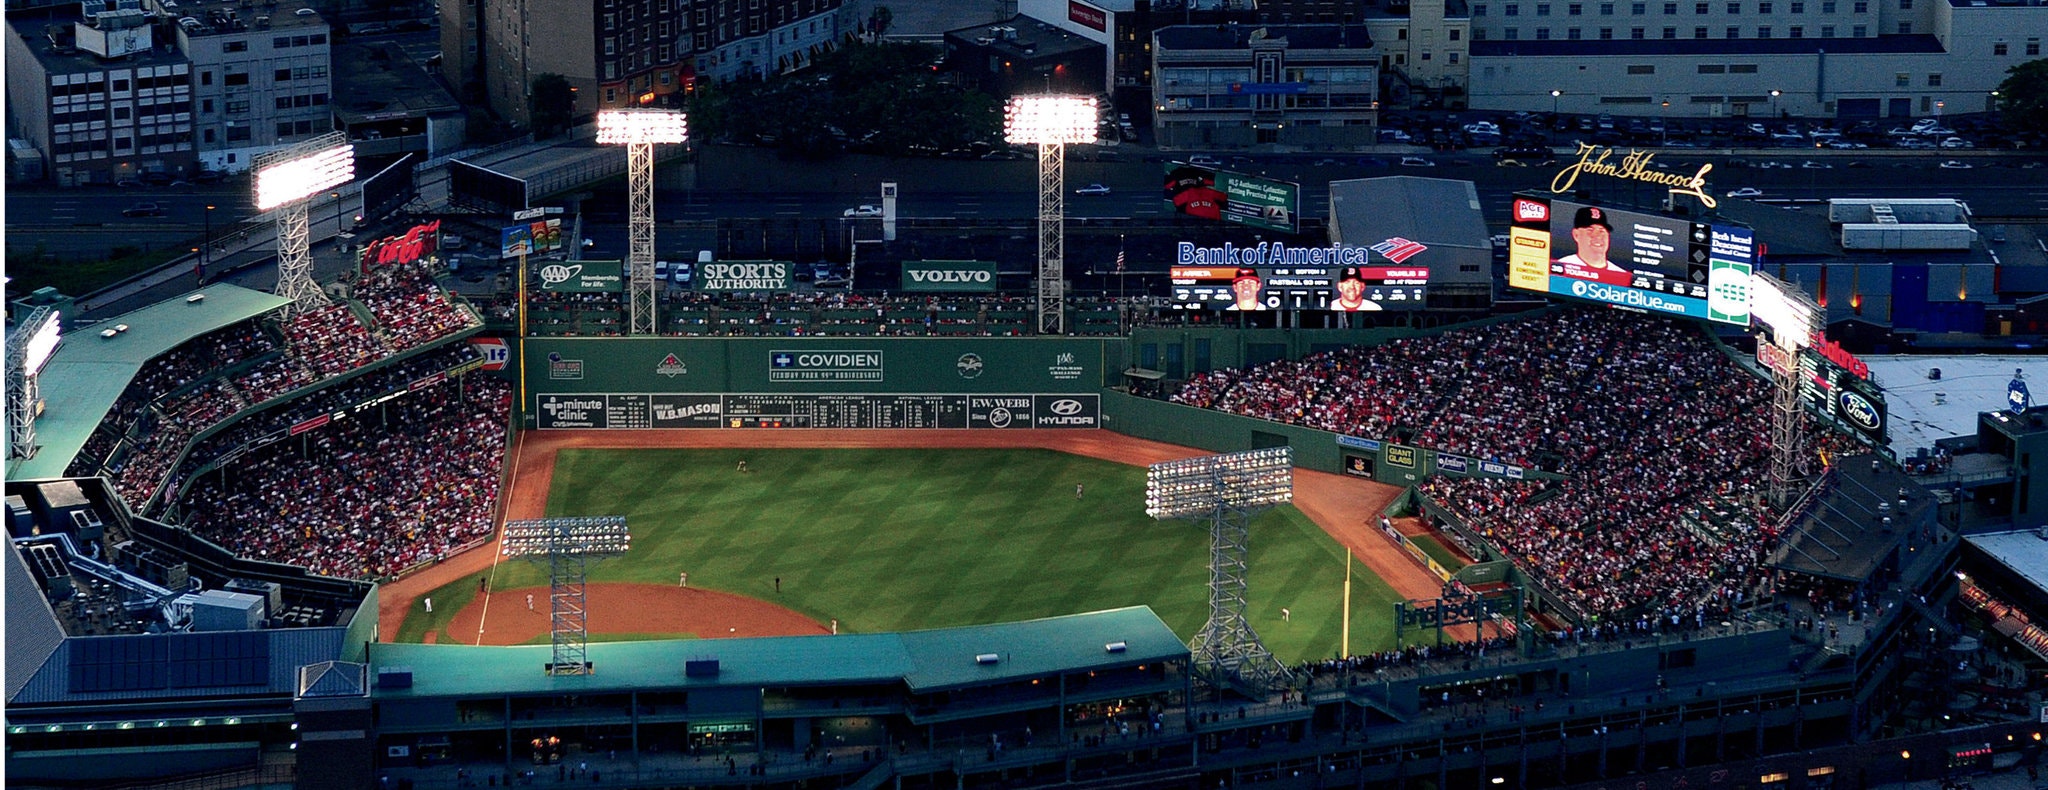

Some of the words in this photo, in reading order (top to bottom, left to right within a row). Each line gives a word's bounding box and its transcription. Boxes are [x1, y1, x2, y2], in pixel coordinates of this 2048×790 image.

[1551, 142, 1615, 193] John
[1615, 148, 1717, 208] Hancock
[1712, 231, 1729, 241] Beth
[1731, 234, 1752, 245] Israel
[1712, 239, 1751, 252] Deaconess
[1178, 242, 1240, 265] Bank
[1241, 242, 1268, 265] of
[1269, 242, 1368, 265] America
[1733, 250, 1751, 258] Center
[703, 263, 786, 279] SPORTS
[908, 270, 991, 282] VOLVO
[1267, 296, 1280, 308] 0
[1296, 296, 1301, 308] 1
[1320, 296, 1325, 308] 1
[1588, 283, 1685, 312] SolarBlue.com
[798, 354, 879, 366] COVIDIEN
[772, 371, 799, 379] FENWAY
[801, 371, 819, 379] PARK
[836, 371, 880, 379] ANNIVERSARY
[563, 399, 602, 410] minute
[995, 399, 1030, 408] WEBB
[1847, 394, 1873, 425] Ford
[557, 409, 588, 420] clinic
[656, 403, 720, 420] W.B.MASON
[1038, 417, 1094, 425] HYUNDAI
[1389, 447, 1412, 457] GIANT
[1389, 455, 1412, 465] GLASS
[1484, 463, 1505, 474] NESN
